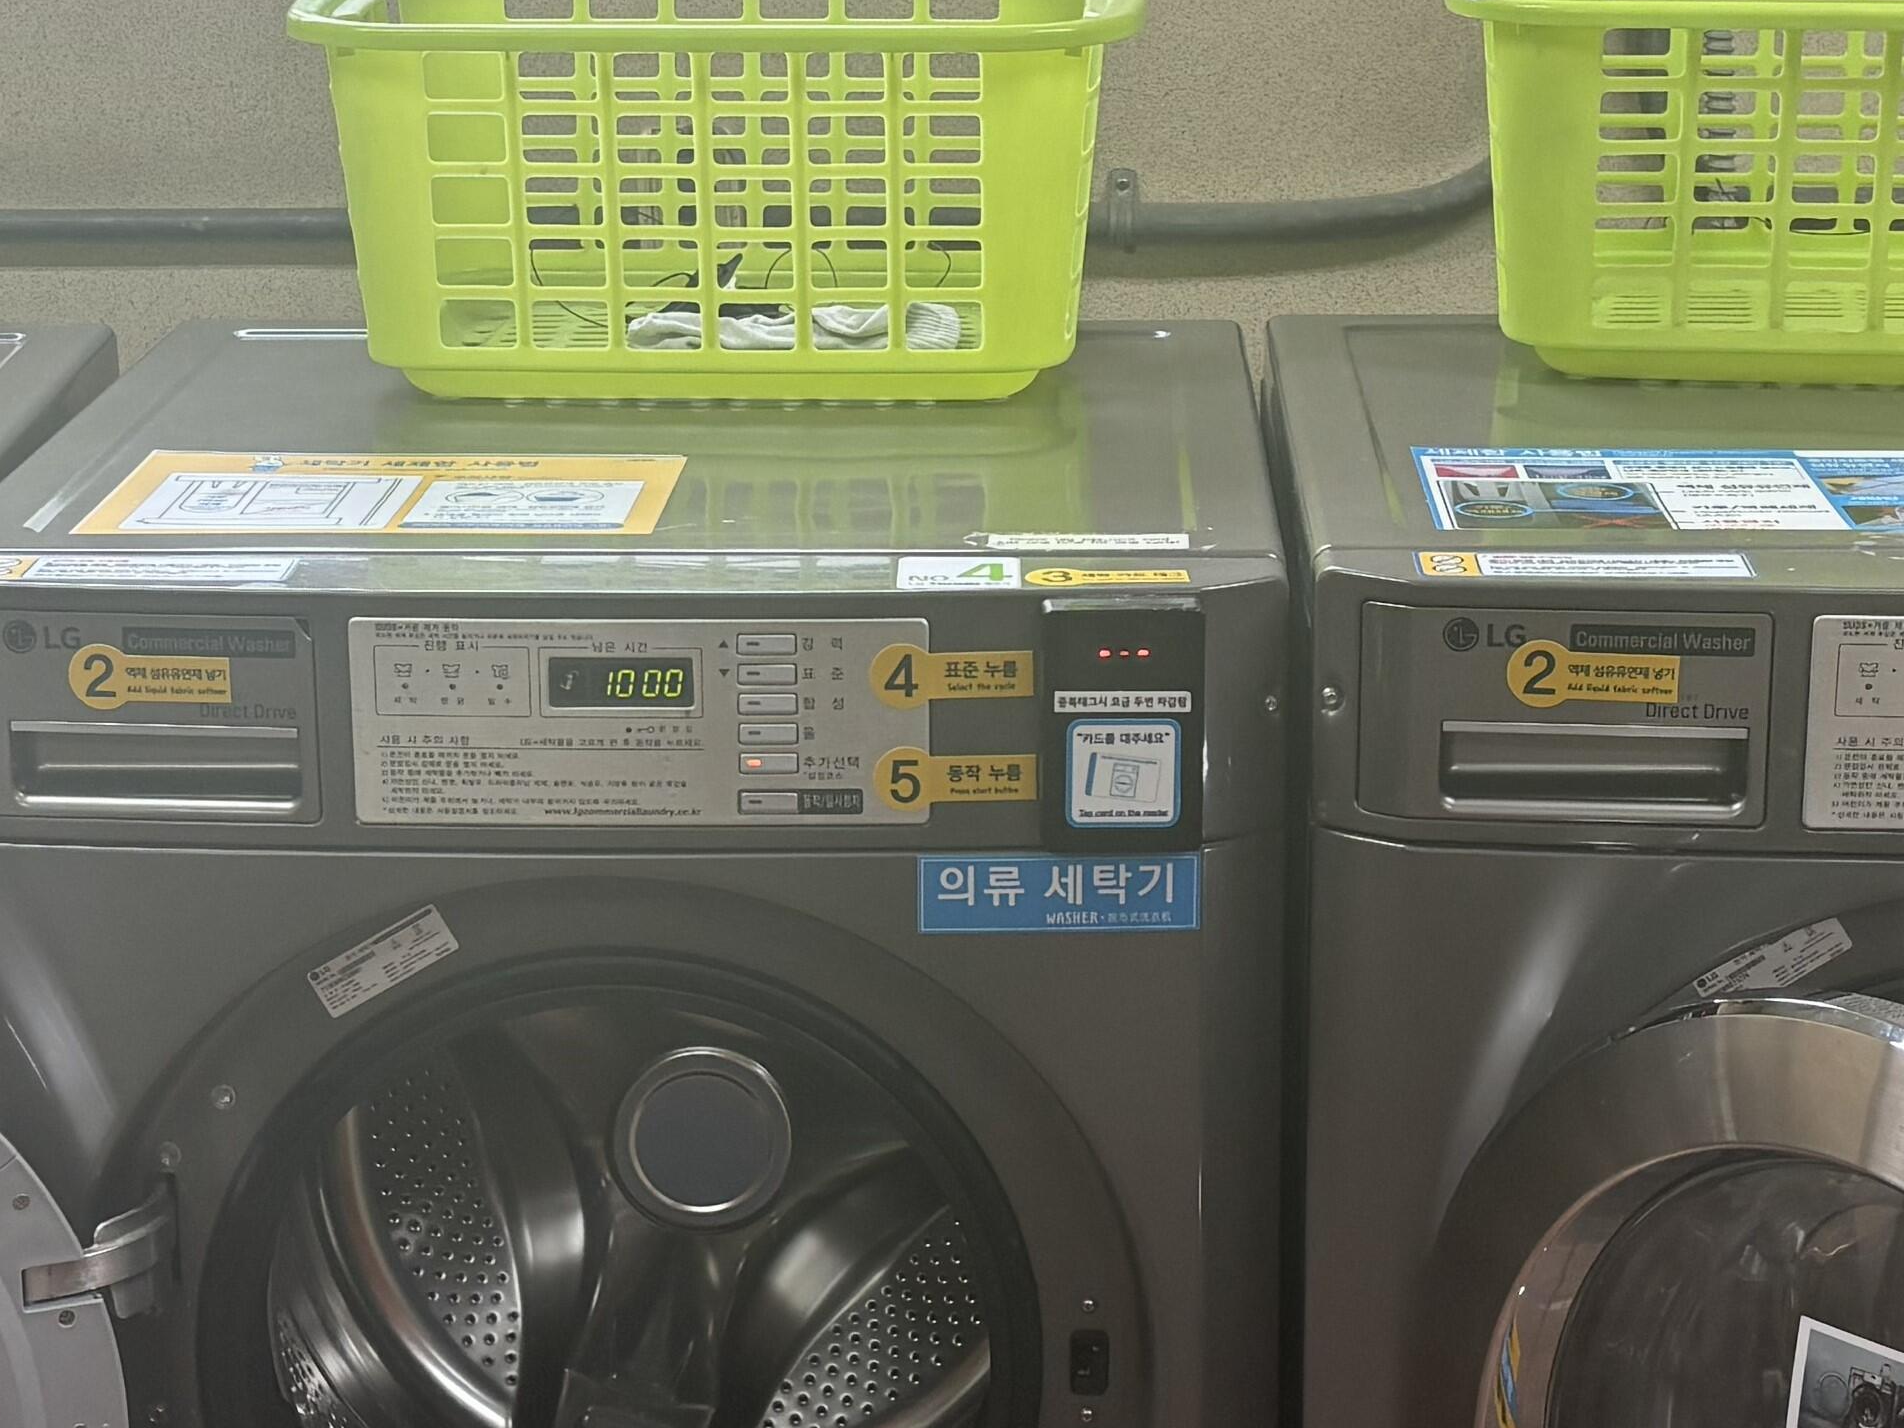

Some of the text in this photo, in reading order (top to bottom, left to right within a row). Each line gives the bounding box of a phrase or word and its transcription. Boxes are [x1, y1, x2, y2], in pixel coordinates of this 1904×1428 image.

[1576, 630, 1752, 653] Commercial Washer
[83, 653, 117, 698] 2
[883, 653, 919, 698] 4
[943, 660, 1019, 679] 표준 누름
[1522, 649, 1556, 696] 2
[1643, 702, 1749, 720] Direct Drive
[890, 759, 921, 804] 5
[946, 763, 1022, 783] 동작 누름
[937, 862, 1174, 907] 의류 세탁기
[1045, 911, 1098, 925] WASHER
